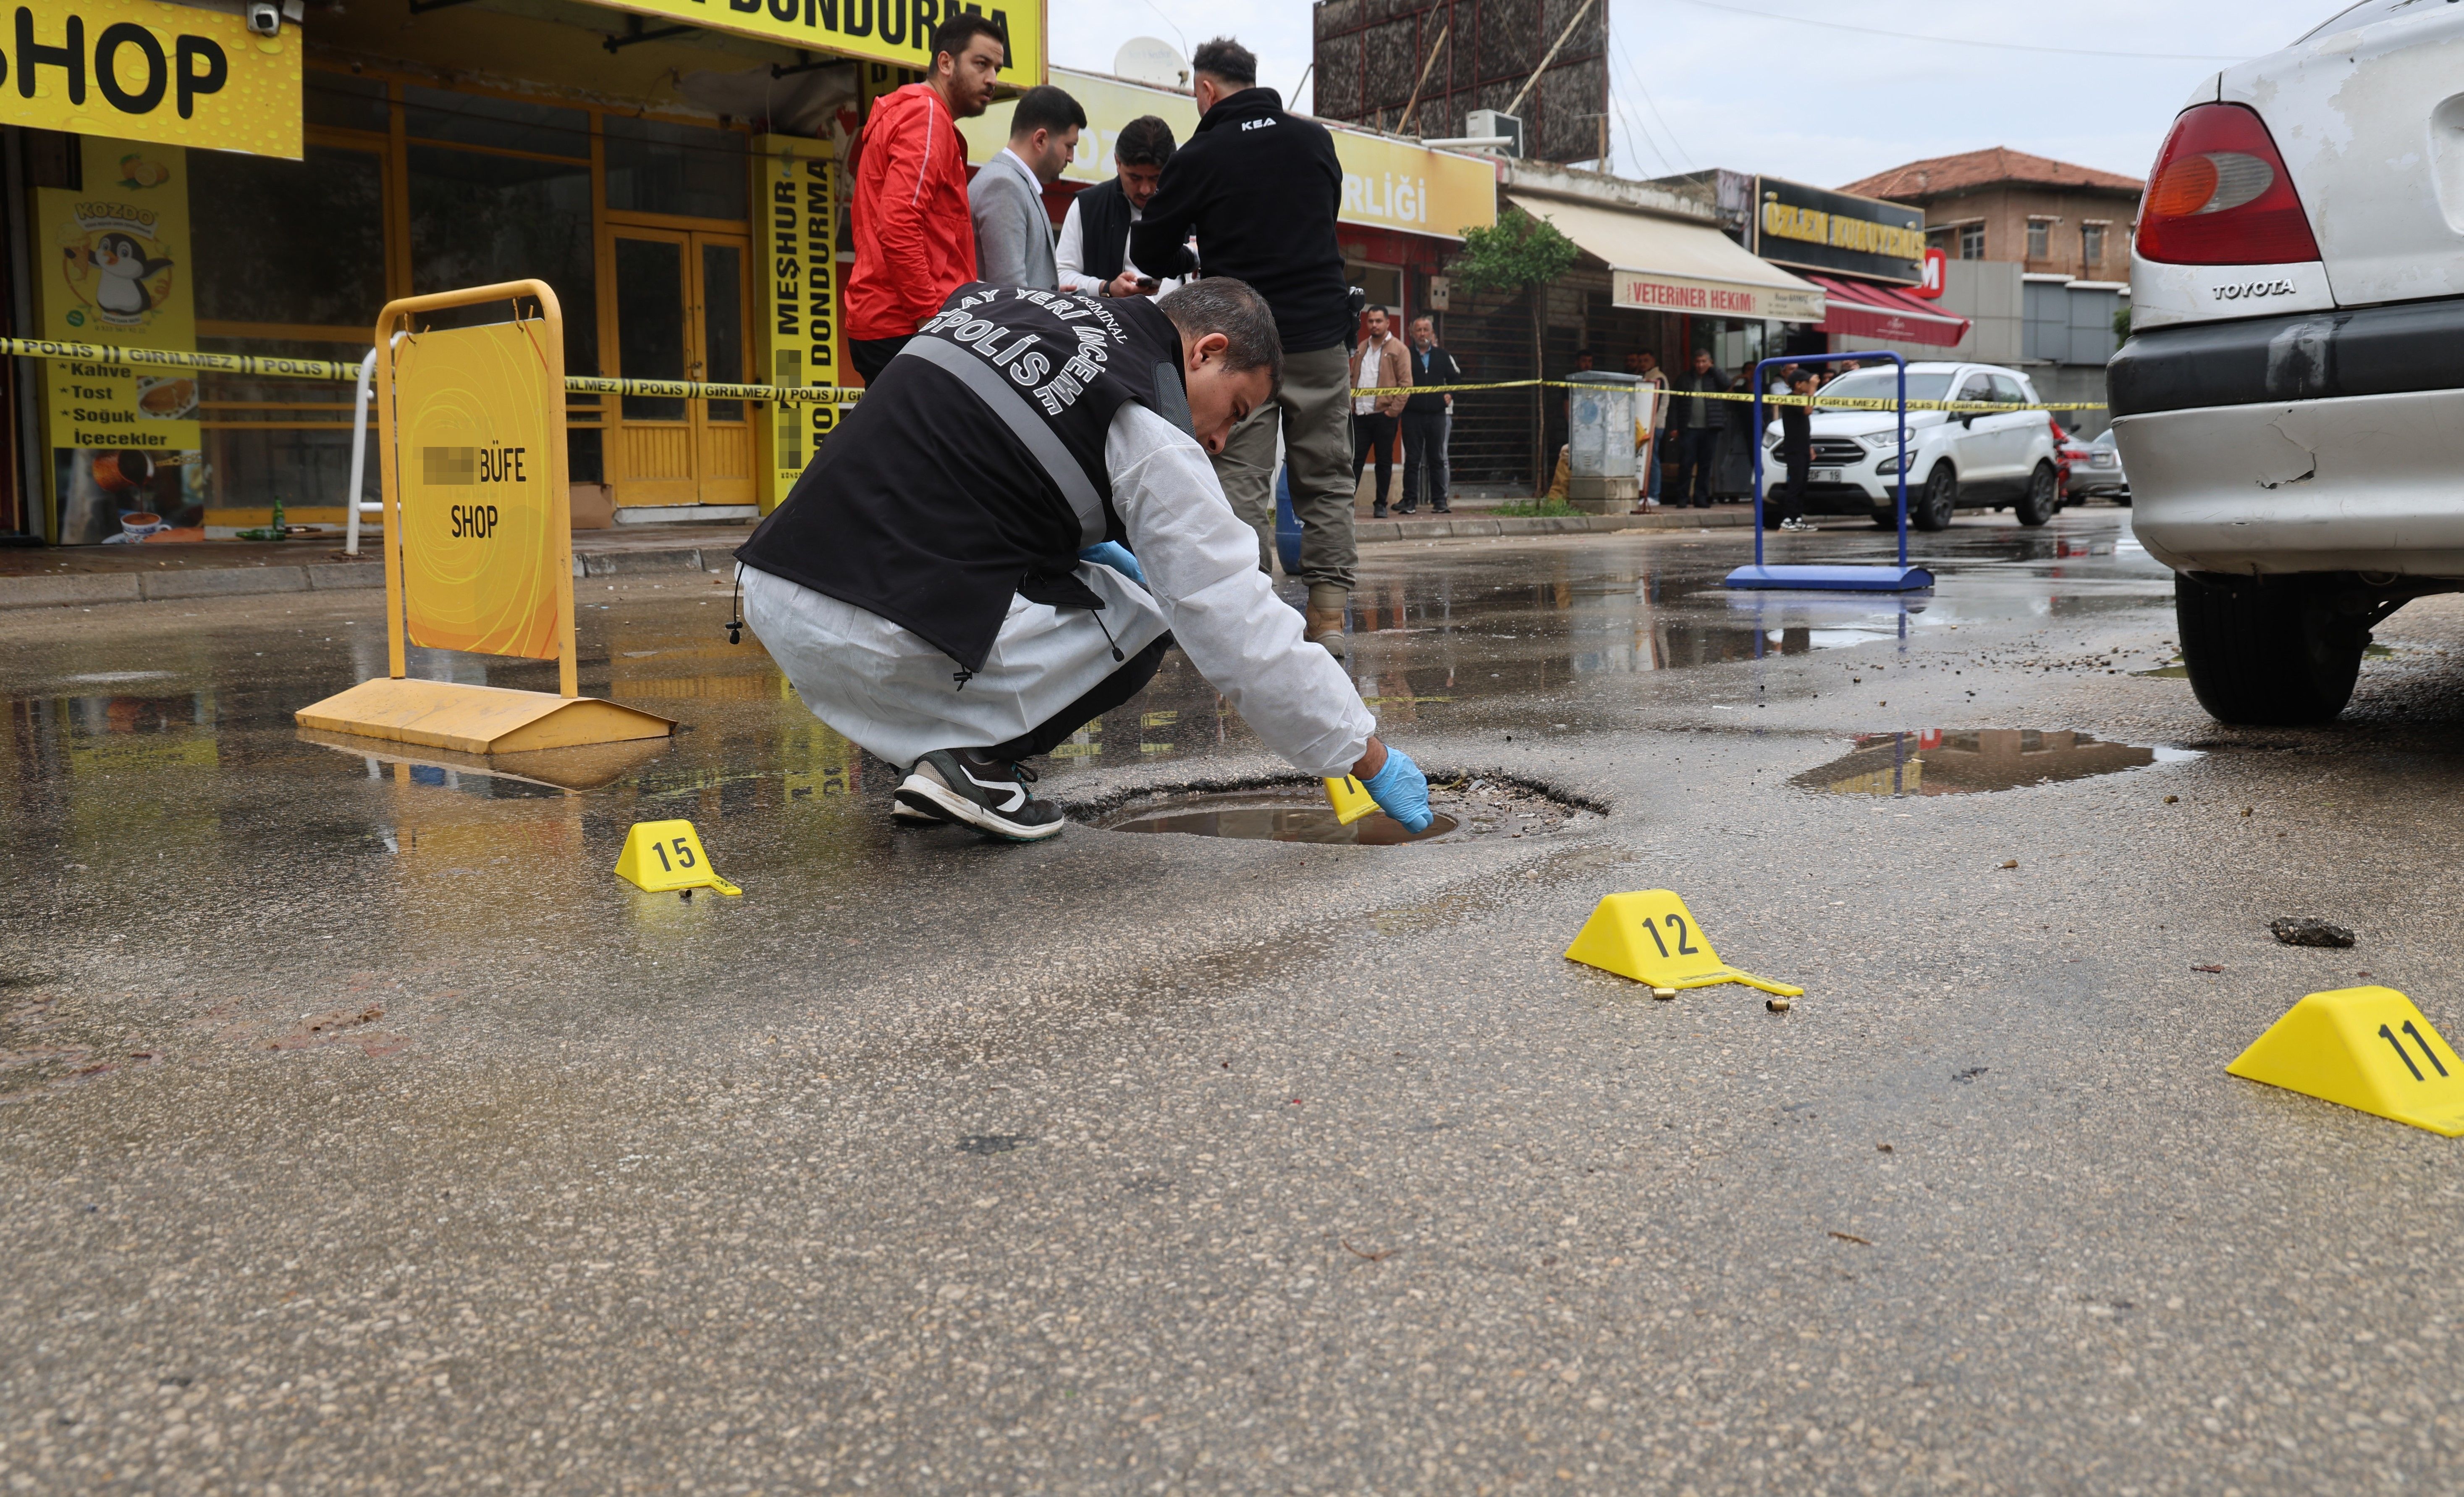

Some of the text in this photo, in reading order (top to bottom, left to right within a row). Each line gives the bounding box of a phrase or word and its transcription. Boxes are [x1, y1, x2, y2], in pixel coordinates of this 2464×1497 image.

[0, 6, 227, 120] HOP
[1242, 117, 1277, 131] KEA
[75, 201, 155, 226] KOZDO
[1342, 171, 1426, 223] RLİĞİ
[1762, 191, 1829, 245] ÖZLEM
[774, 181, 801, 335] MEŞHUR
[806, 160, 834, 366] DONDURMA
[1015, 287, 1092, 320] YERİ
[2213, 278, 2296, 300] TOYOTA
[1072, 295, 1128, 344] KRİMİNAL
[930, 311, 1050, 386] POLİS
[71, 363, 131, 378] Kahve
[71, 385, 113, 399] Tost
[73, 408, 135, 423] Soğuk
[74, 428, 167, 446] İçecekler
[481, 439, 527, 482] BÜFE
[451, 505, 498, 538] SHOP
[652, 837, 695, 872] 15
[1642, 914, 1699, 958] 12
[2378, 1020, 2450, 1082] 11
